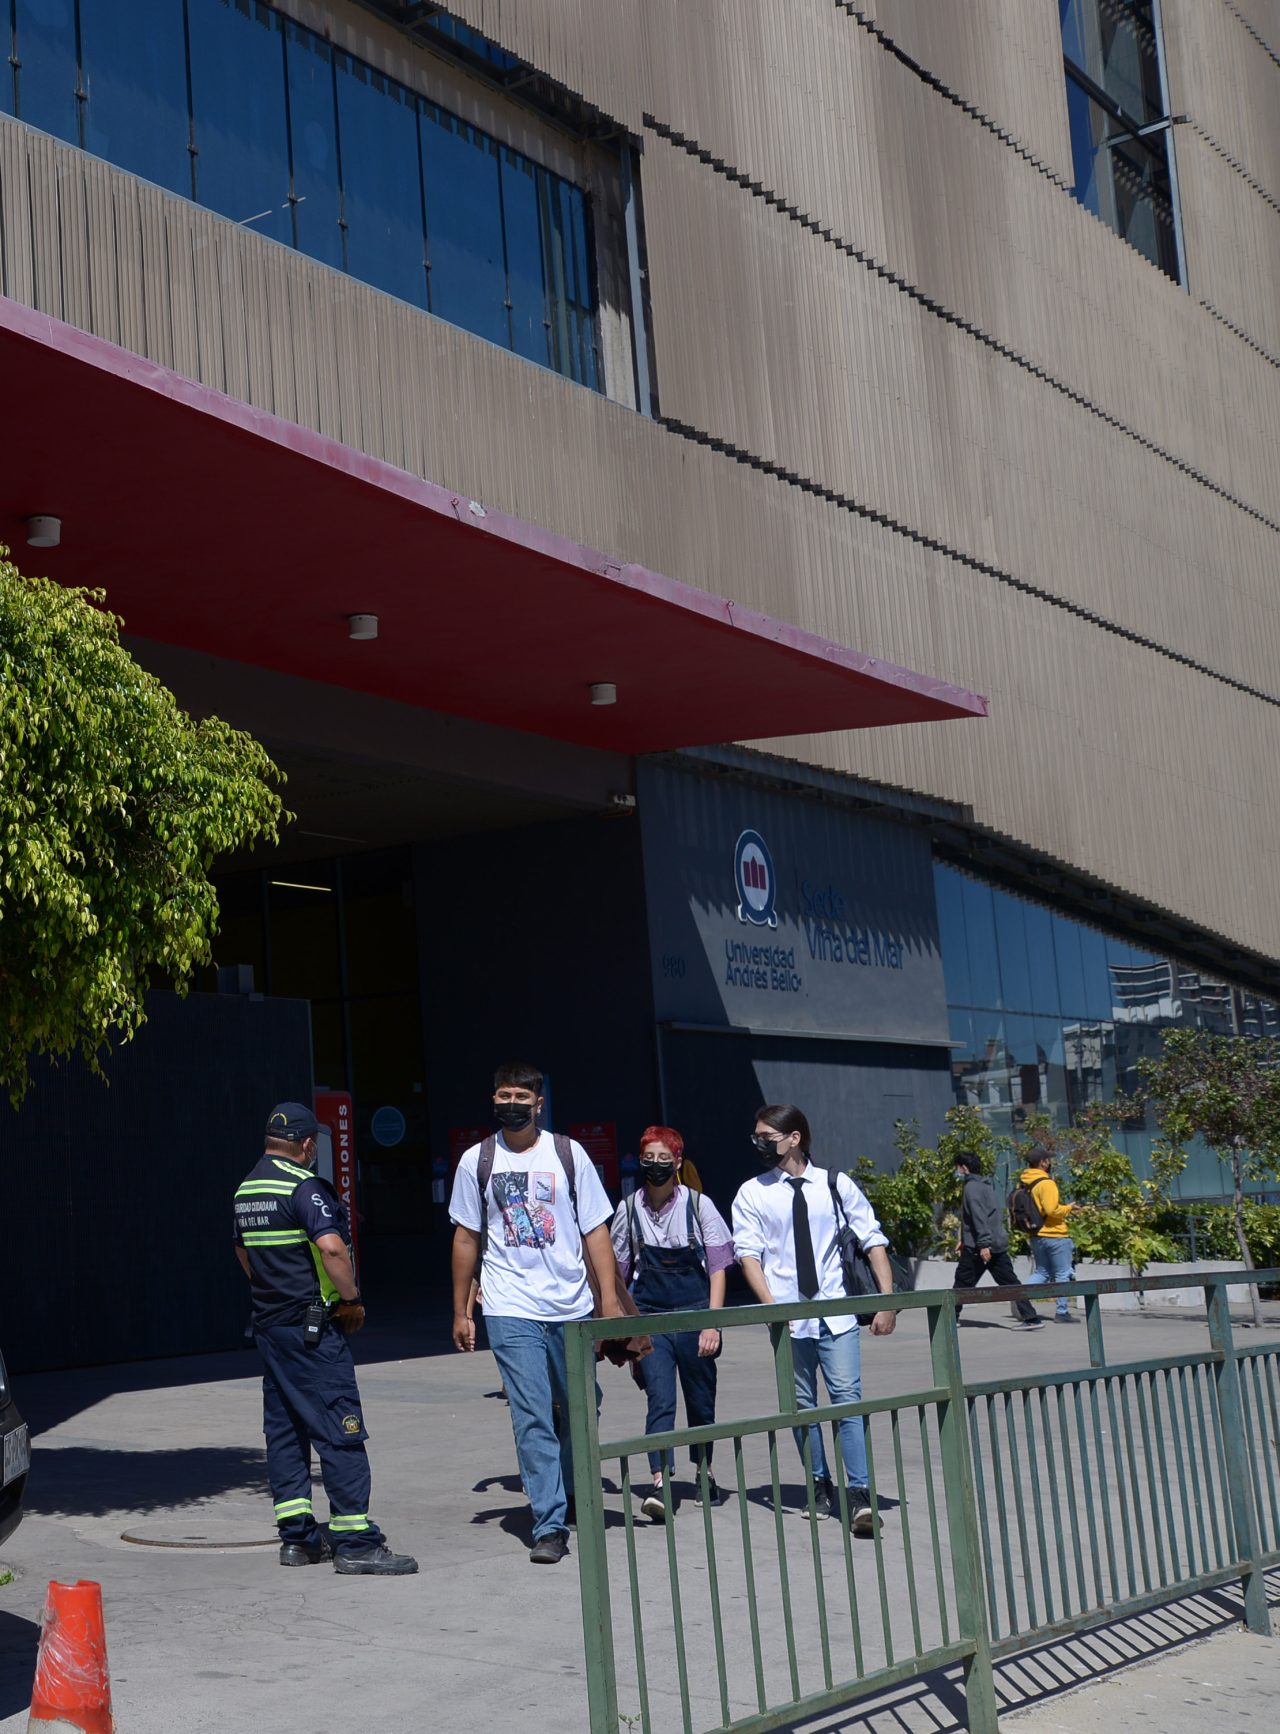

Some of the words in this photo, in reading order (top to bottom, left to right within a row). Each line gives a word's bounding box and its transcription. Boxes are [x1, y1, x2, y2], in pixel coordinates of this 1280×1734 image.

[801, 880, 847, 922] Sede
[725, 939, 796, 969] Universidad
[805, 922, 844, 964] Viña
[847, 930, 872, 966] del
[874, 935, 905, 971] Mar
[725, 965, 768, 991] Andrés
[771, 967, 800, 993] Bello
